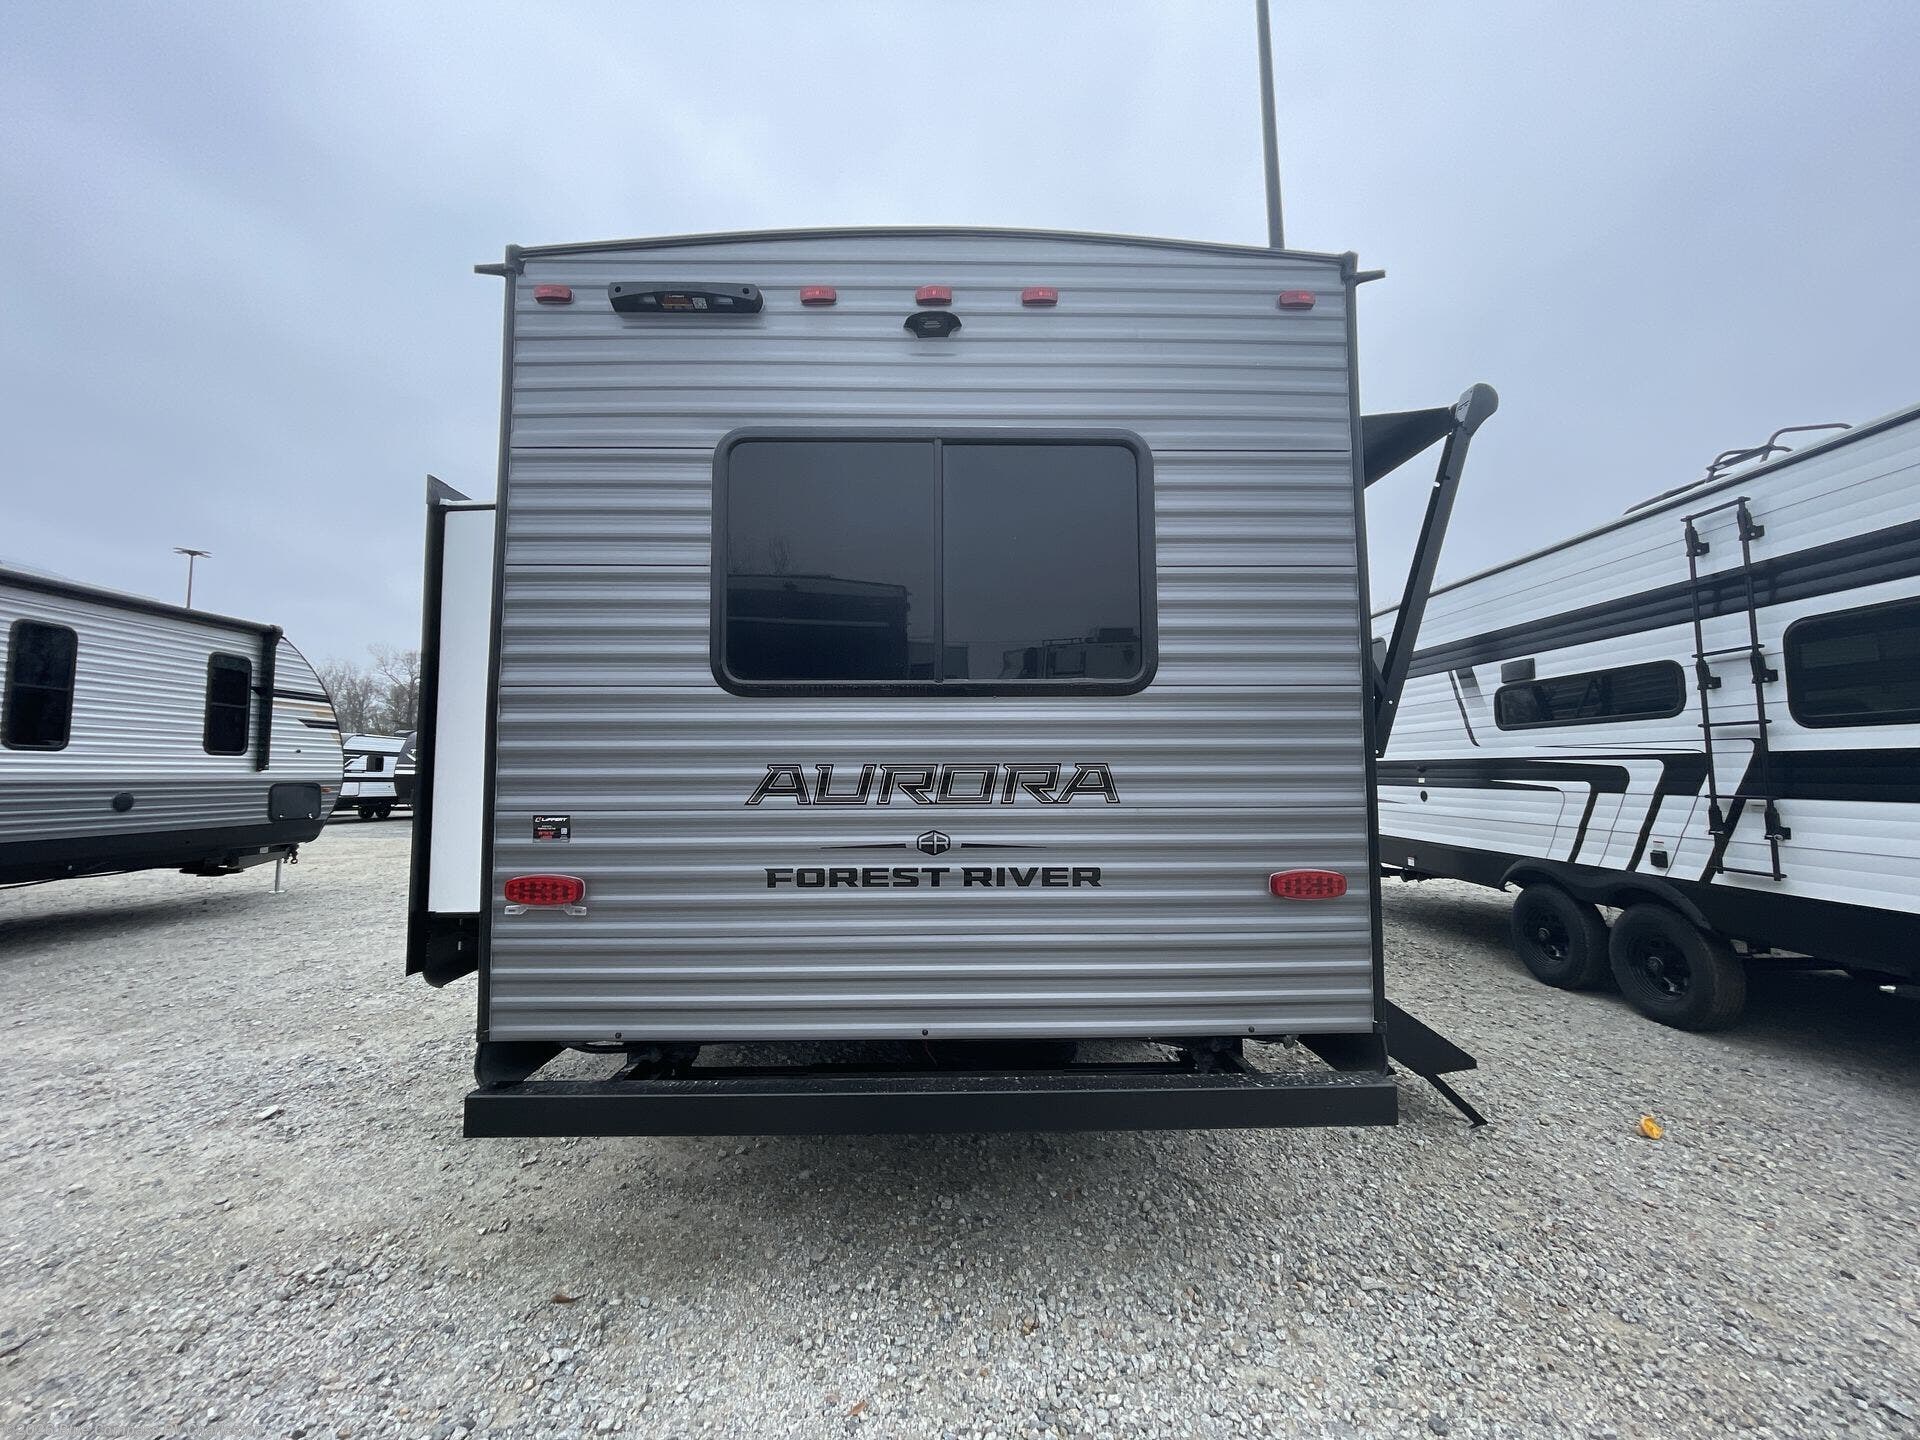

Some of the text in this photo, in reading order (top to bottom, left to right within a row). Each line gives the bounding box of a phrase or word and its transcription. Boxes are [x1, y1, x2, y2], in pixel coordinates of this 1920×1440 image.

[744, 763, 1121, 806] AURORA
[764, 866, 1102, 888] FOREST RIVER
